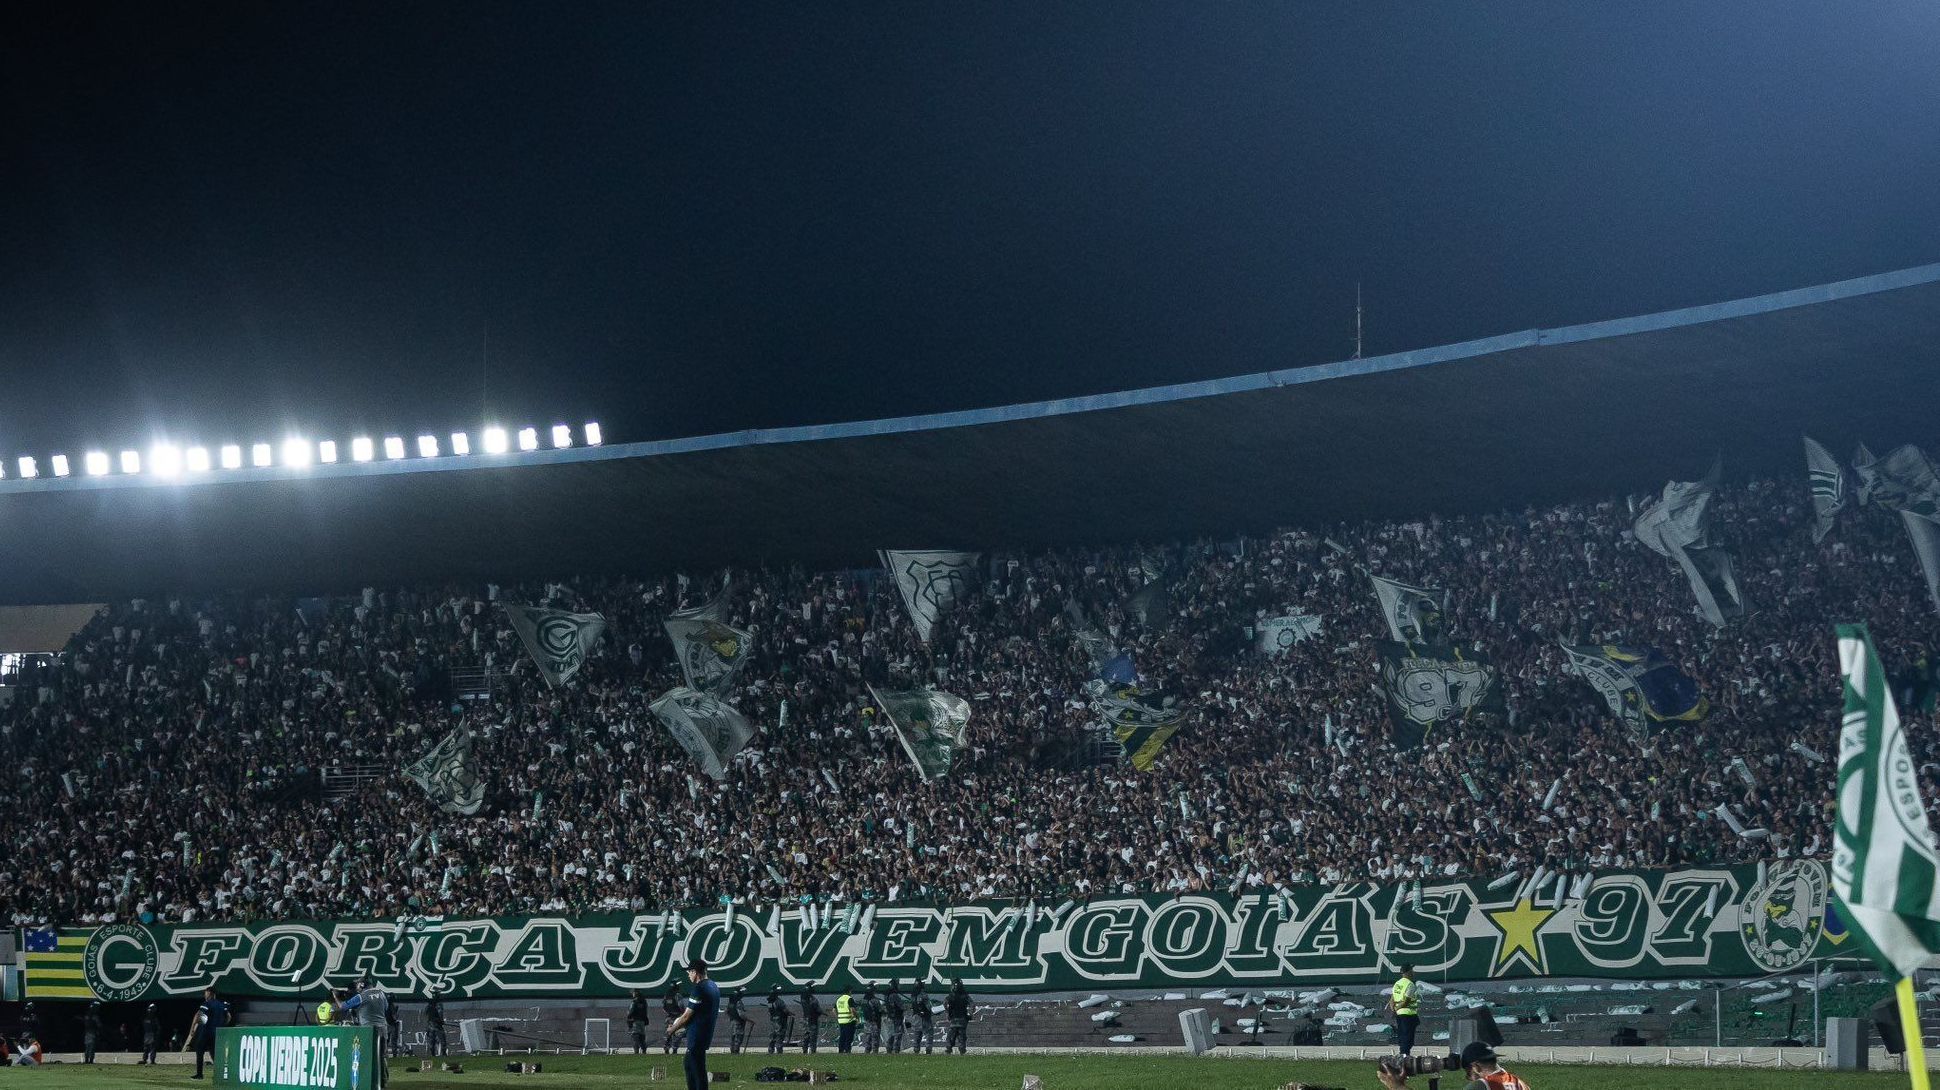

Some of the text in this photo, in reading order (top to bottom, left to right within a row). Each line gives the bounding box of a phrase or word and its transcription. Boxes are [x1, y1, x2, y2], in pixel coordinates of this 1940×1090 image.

[1587, 671, 1618, 706] CLUBE
[97, 934, 146, 989] G
[99, 924, 144, 940] ESPORTE
[142, 944, 154, 979] CLUBE
[158, 917, 586, 998] FORÇA
[600, 906, 1048, 989] JOVEM
[1062, 882, 1466, 979] GOIÁS
[1572, 870, 1739, 967] 97
[239, 1035, 339, 1088] COPA VERDE 2025
